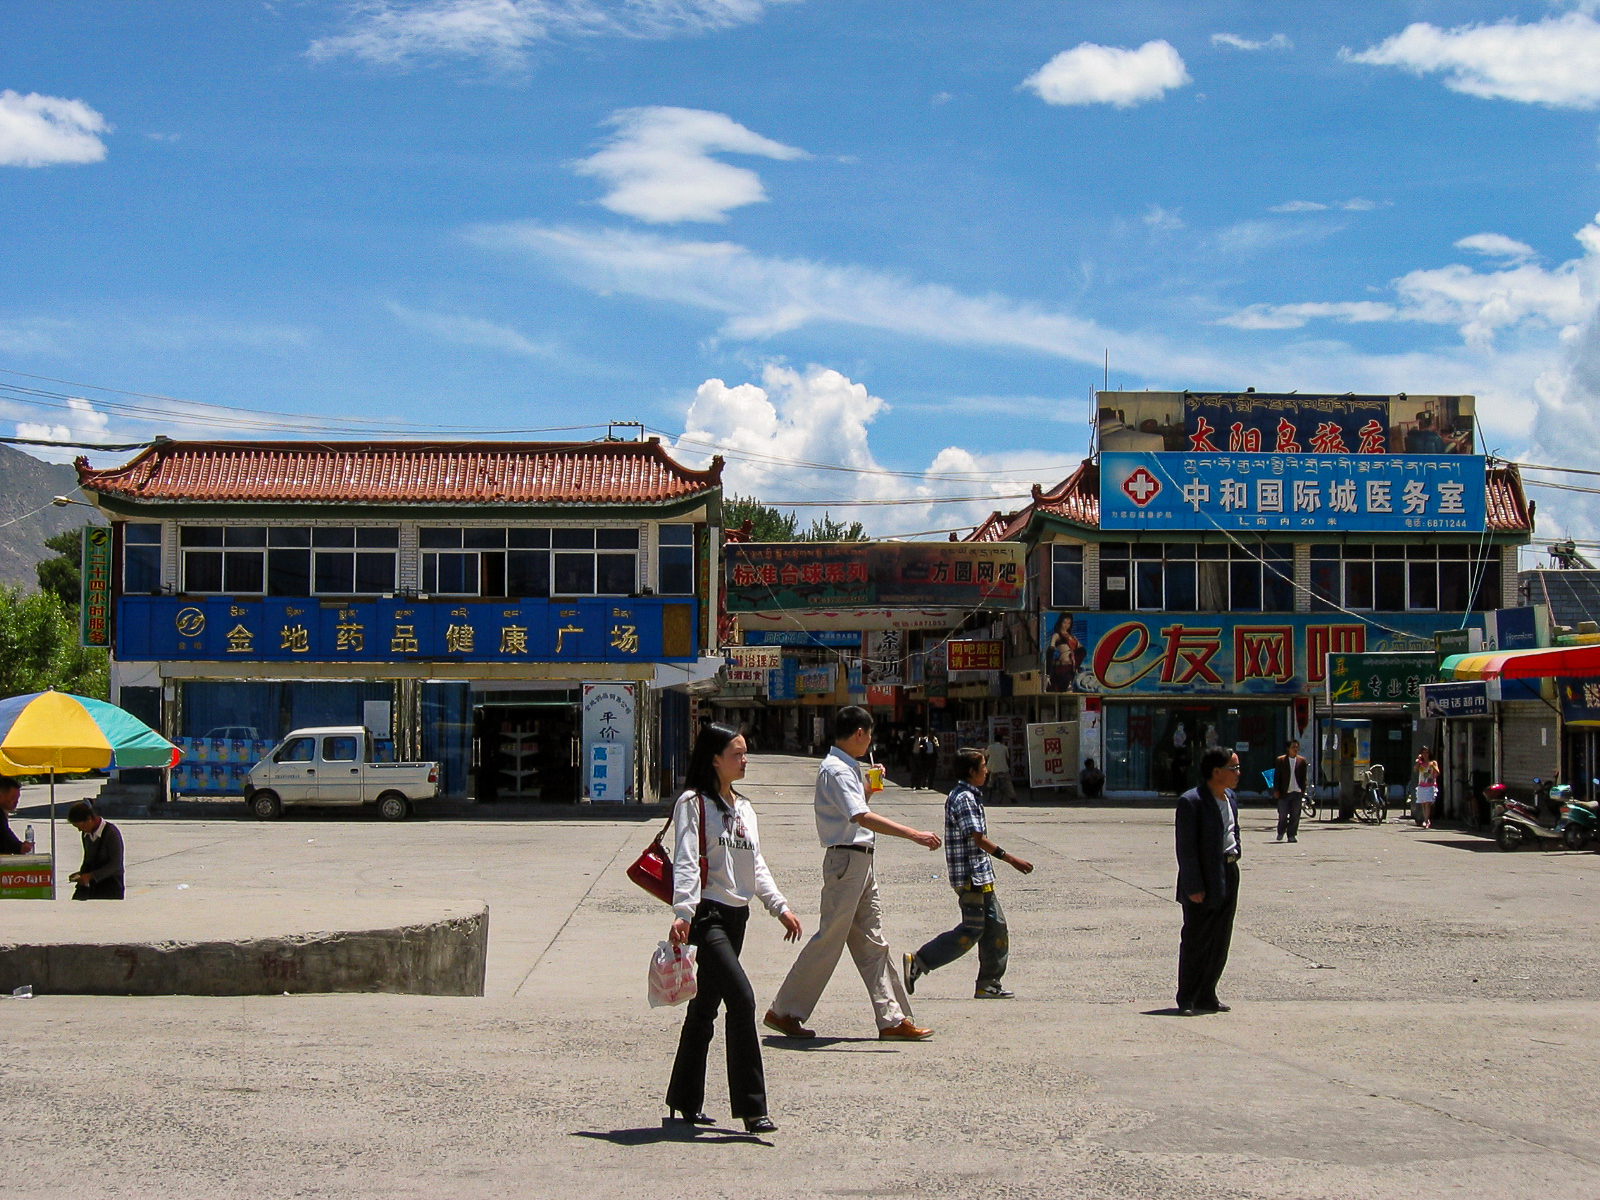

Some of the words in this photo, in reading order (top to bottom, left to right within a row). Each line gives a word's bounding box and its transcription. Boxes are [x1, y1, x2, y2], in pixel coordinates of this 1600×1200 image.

[1183, 478, 1466, 514] 中和国际城医务室
[733, 563, 868, 586] 标准台球系列
[931, 561, 1017, 583] 方圆网吧
[88, 554, 107, 644] 二十四小时服务
[226, 623, 638, 653] 金地药品健康广场
[951, 643, 1000, 655] 网吧旅店
[951, 656, 1000, 668] 请上二楼
[1368, 674, 1437, 698] 专业美
[1439, 696, 1485, 709] 电话超市
[599, 711, 620, 743] 平价
[1012, 717, 1026, 778] 空调开放
[1043, 737, 1065, 775] 网吧
[593, 747, 608, 797] 高原宁
